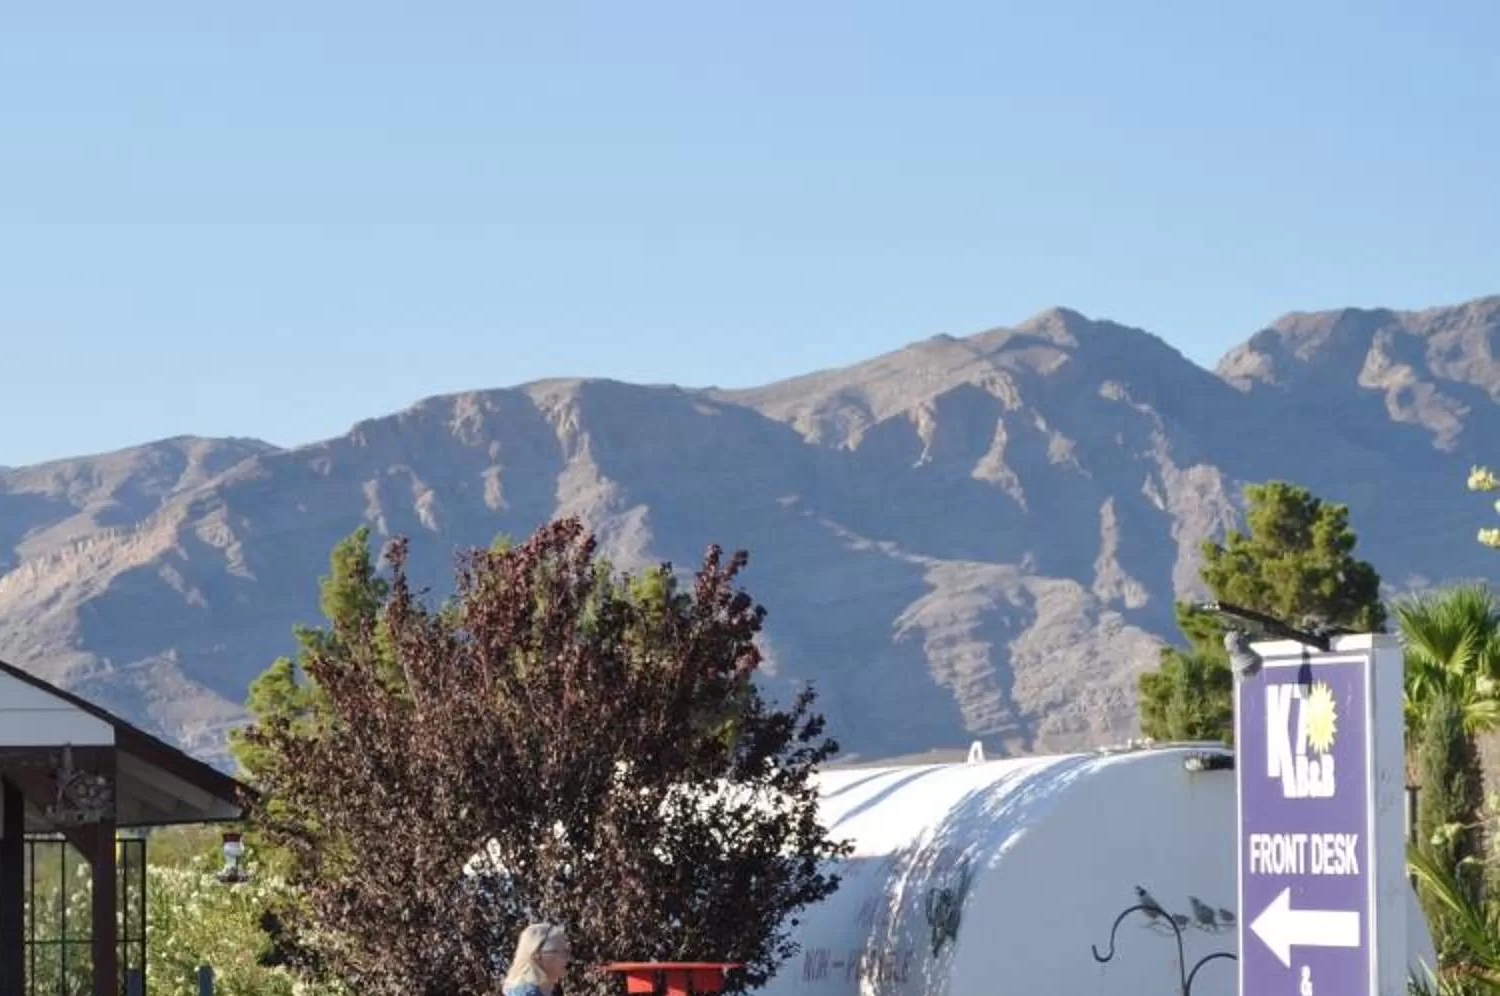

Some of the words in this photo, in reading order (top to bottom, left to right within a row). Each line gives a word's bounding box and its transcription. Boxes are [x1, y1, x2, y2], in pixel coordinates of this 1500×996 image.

[1250, 833, 1308, 875] FRONT
[1311, 833, 1359, 876] DESK
[1300, 965, 1313, 996] &
